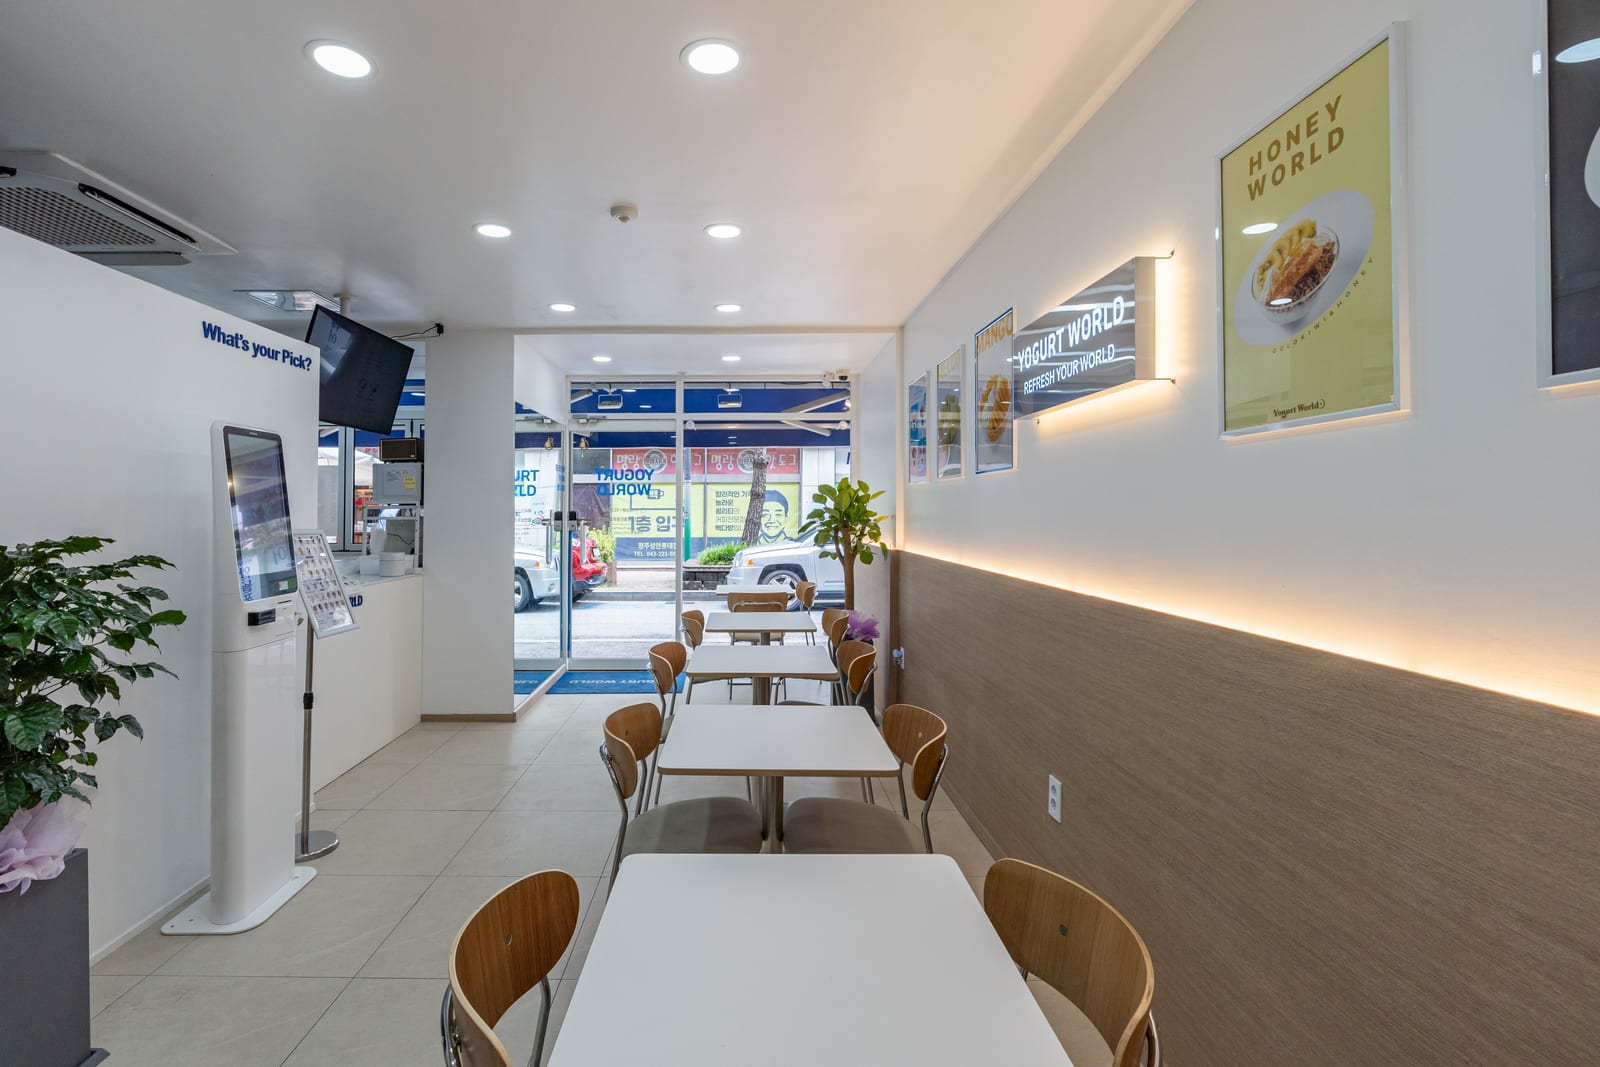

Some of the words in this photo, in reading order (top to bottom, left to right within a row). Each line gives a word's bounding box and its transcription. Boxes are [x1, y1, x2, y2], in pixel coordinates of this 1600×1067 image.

[1249, 94, 1342, 176] HONEY
[1247, 126, 1344, 201] WORLD
[201, 320, 250, 352] What's
[251, 342, 281, 361] your
[282, 349, 312, 371] Pick?
[1018, 327, 1065, 372] YOGURT
[1067, 295, 1125, 348] WORLD
[1023, 370, 1055, 395] REFRESH
[1056, 359, 1079, 382] YOUR
[1079, 343, 1116, 372] WORLD
[1272, 406, 1297, 419] Yogurt
[711, 453, 735, 471] 명랑
